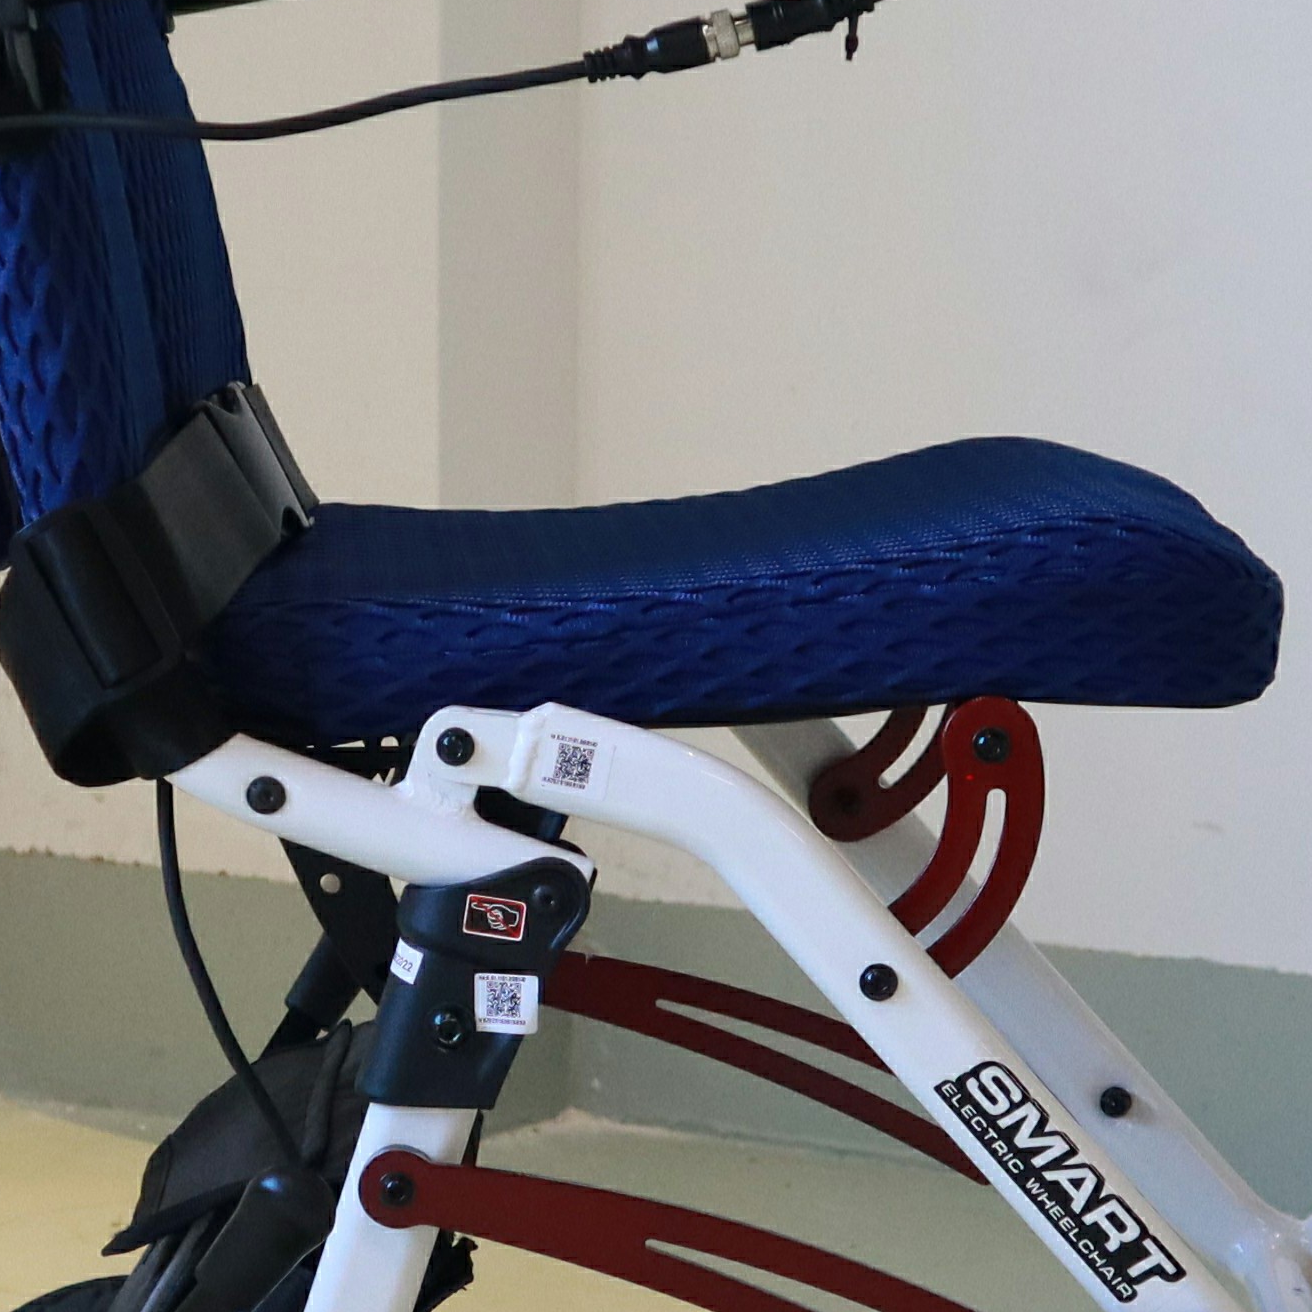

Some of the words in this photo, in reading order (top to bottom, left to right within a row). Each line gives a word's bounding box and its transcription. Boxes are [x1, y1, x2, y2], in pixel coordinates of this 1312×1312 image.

[941, 1082, 1024, 1174] ELECTRIC
[1025, 1177, 1133, 1299] WHEELCHAIR
[966, 1065, 1177, 1278] SMART
